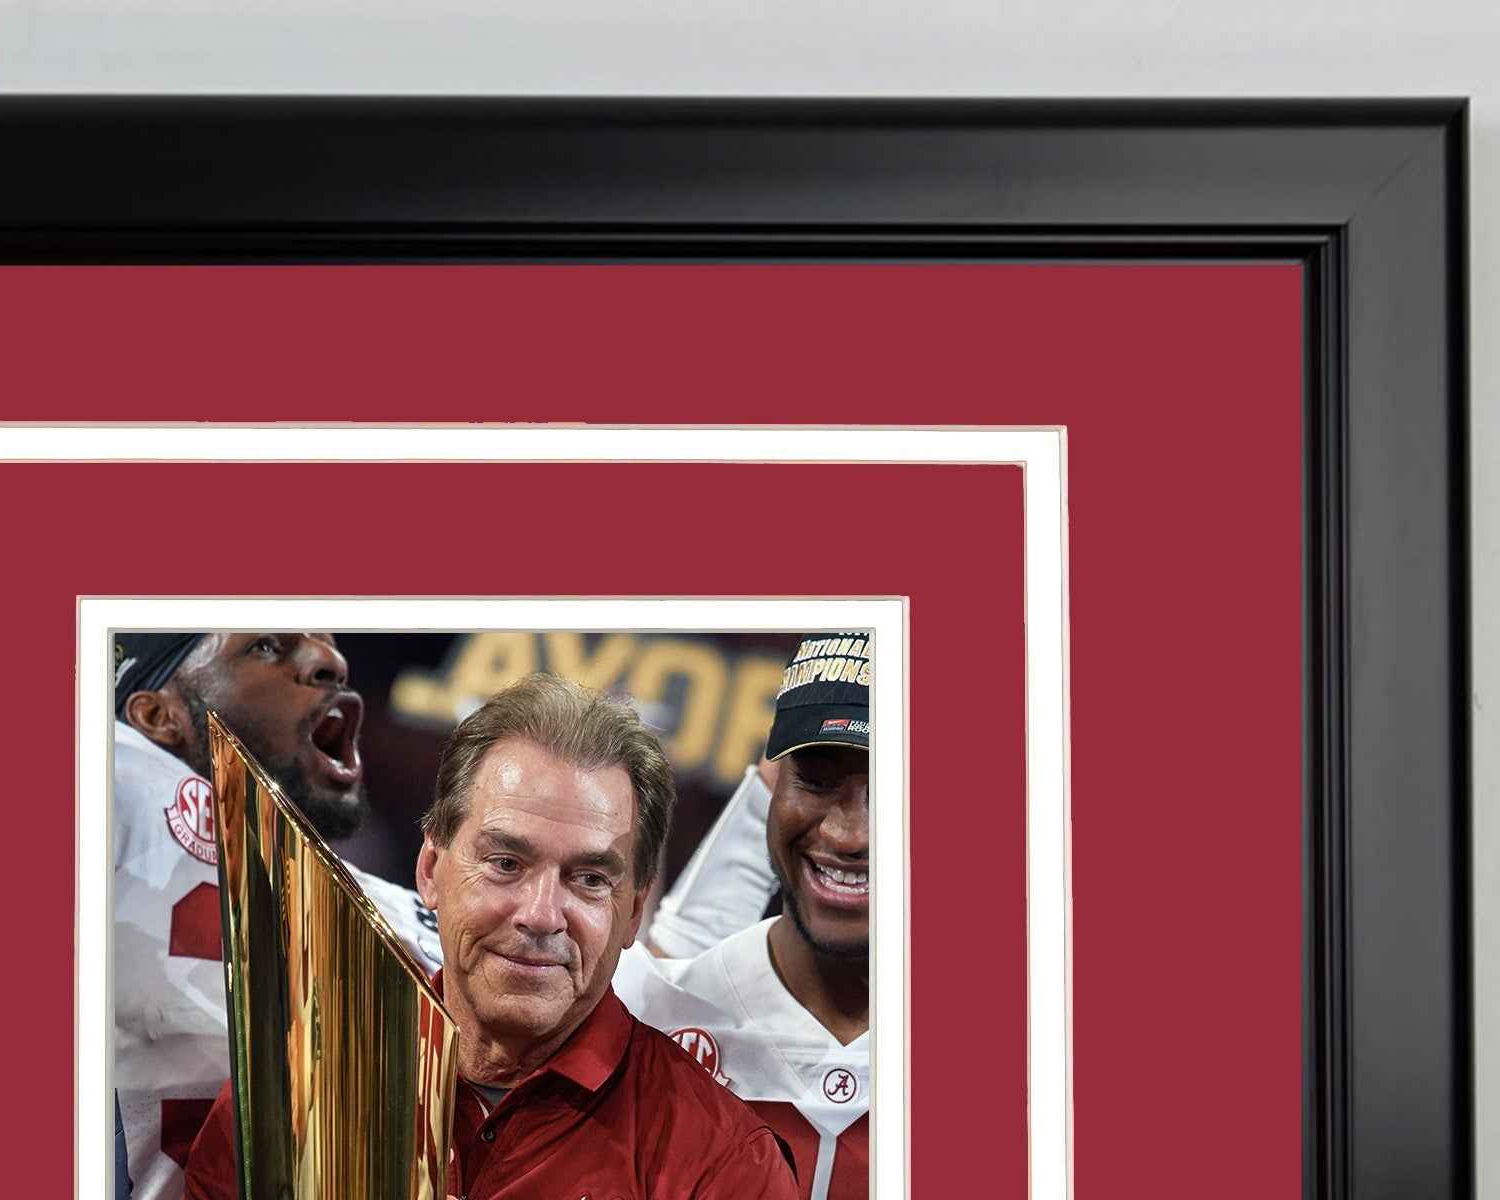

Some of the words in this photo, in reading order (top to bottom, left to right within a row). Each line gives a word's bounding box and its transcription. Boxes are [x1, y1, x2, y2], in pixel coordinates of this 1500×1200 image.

[777, 657, 869, 699] HAMPIONS
[180, 779, 213, 841] SE
[827, 1073, 850, 1097] A
